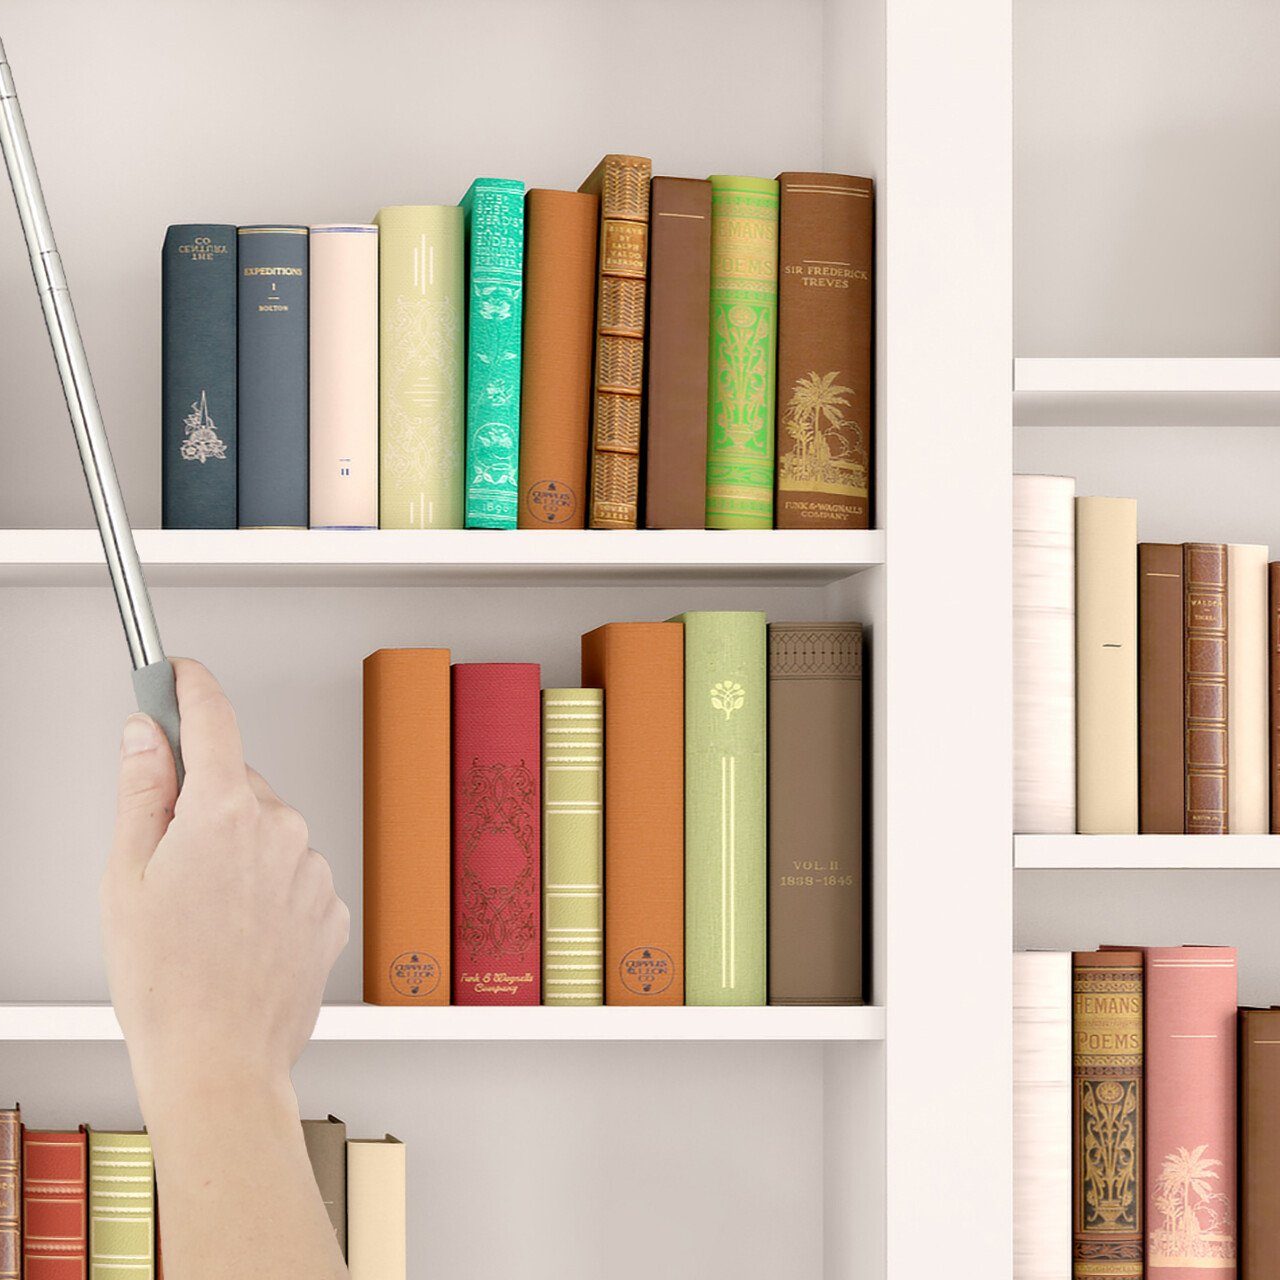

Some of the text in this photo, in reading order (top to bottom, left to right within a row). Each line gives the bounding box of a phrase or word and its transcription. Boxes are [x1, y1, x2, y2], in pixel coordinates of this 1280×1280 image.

[243, 266, 303, 277] EXPEDITIONS
[784, 265, 868, 280] SIR FREDERICK
[801, 276, 850, 289] TREVES
[800, 510, 850, 521] COMPANY
[1074, 994, 1140, 1014] HEMANS
[1075, 1031, 1139, 1051] POEMS
